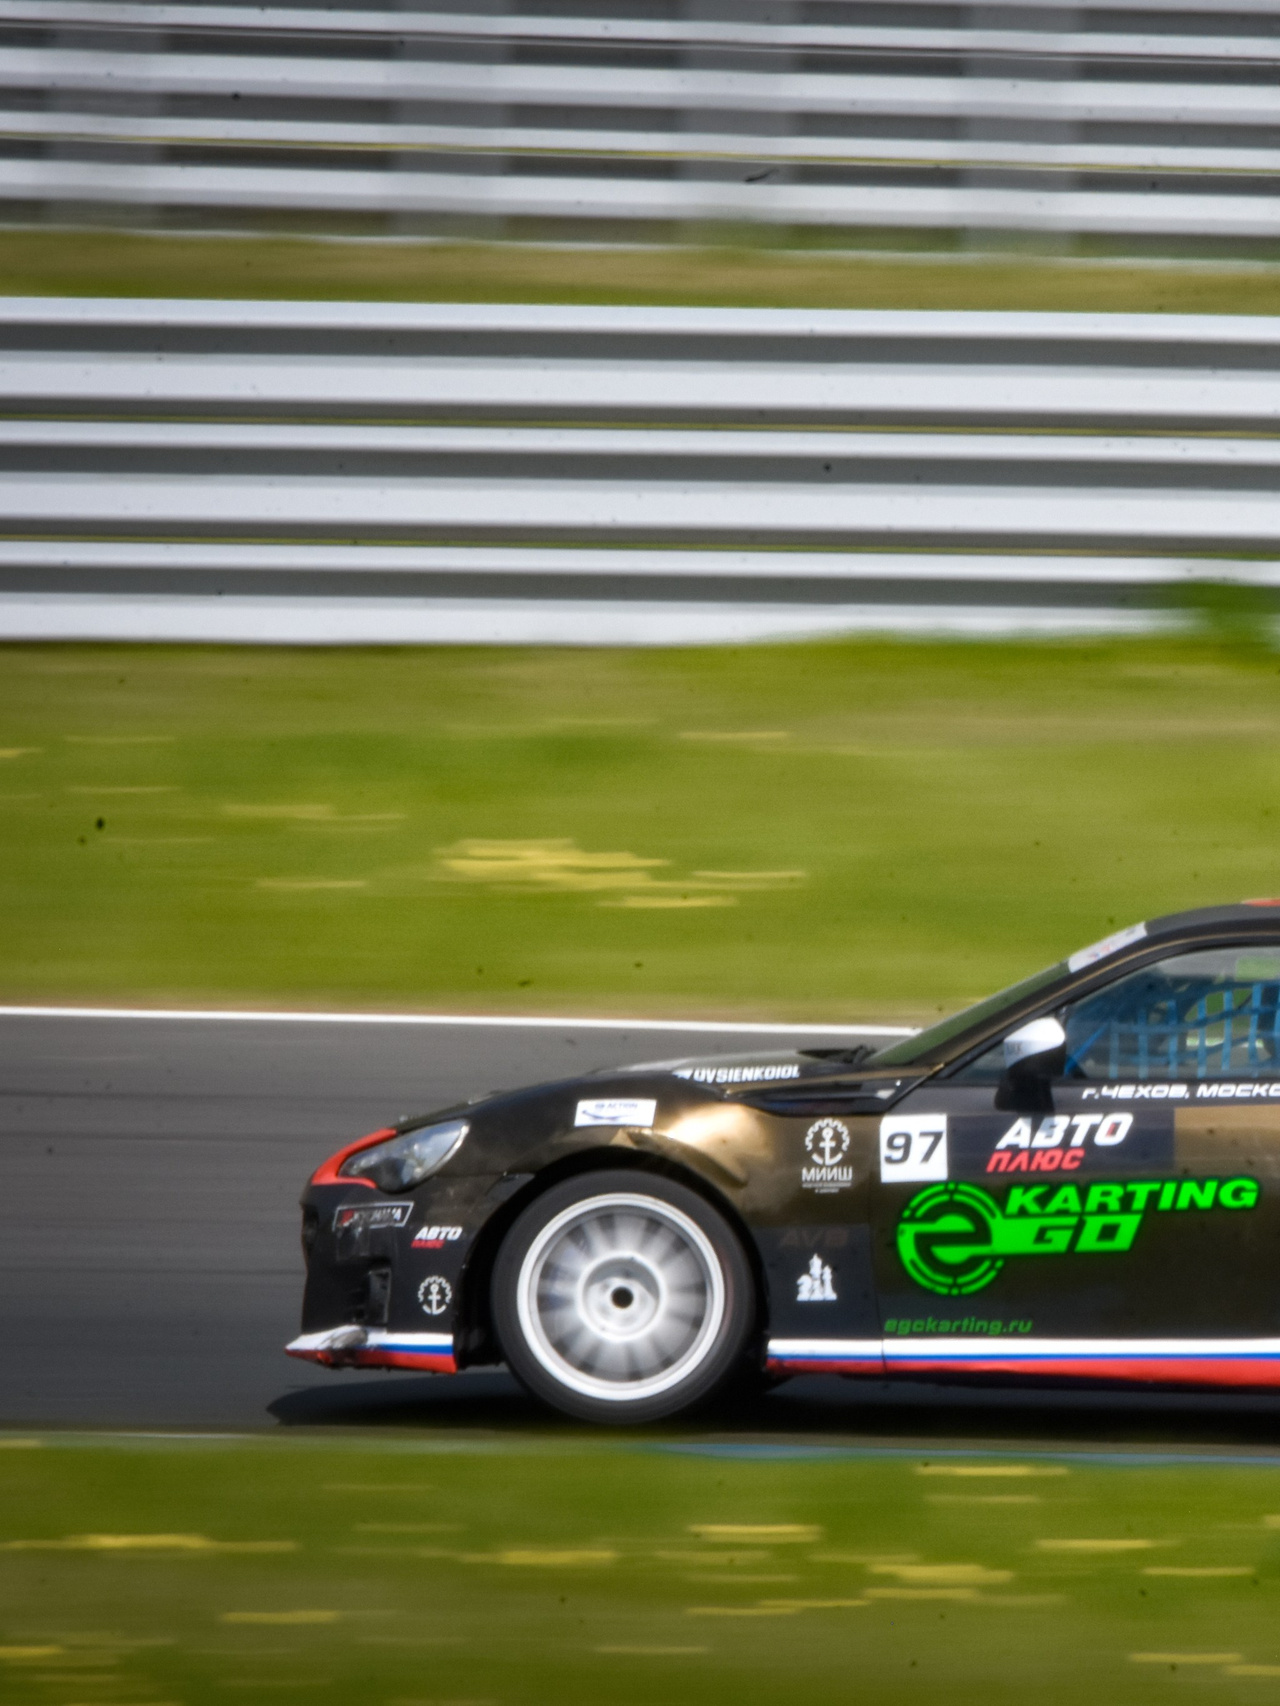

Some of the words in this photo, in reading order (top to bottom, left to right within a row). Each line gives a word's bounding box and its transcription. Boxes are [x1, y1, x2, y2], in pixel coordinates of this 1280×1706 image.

[884, 1130, 945, 1165] 97
[995, 1112, 1134, 1149] АВТО
[801, 1166, 853, 1182] МИИШ
[986, 1148, 1085, 1173] ПЛЮС
[1004, 1177, 1260, 1215] KARTING
